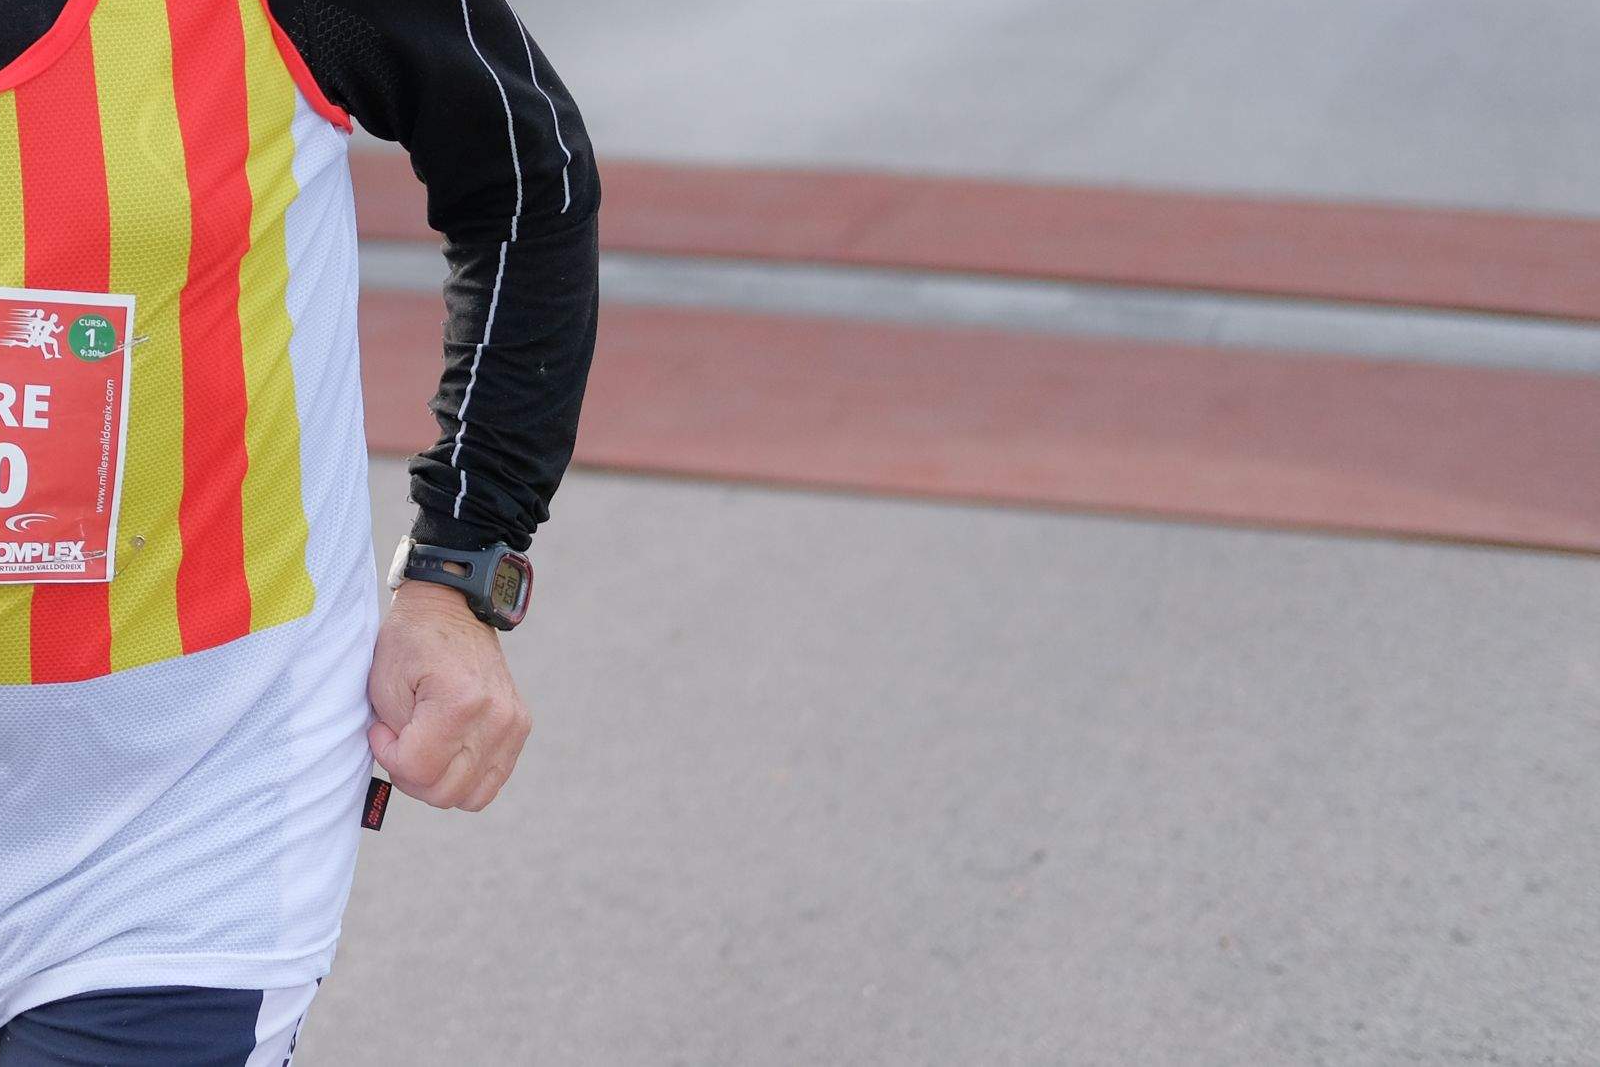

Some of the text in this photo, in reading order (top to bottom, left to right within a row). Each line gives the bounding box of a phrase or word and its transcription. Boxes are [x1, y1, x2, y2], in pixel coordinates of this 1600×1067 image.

[78, 318, 107, 328] CURSA
[84, 327, 96, 347] 1
[95, 379, 114, 514] www.millesvalldoreix.com
[19, 564, 35, 572] EMD
[36, 563, 82, 571] VALLDOREIX
